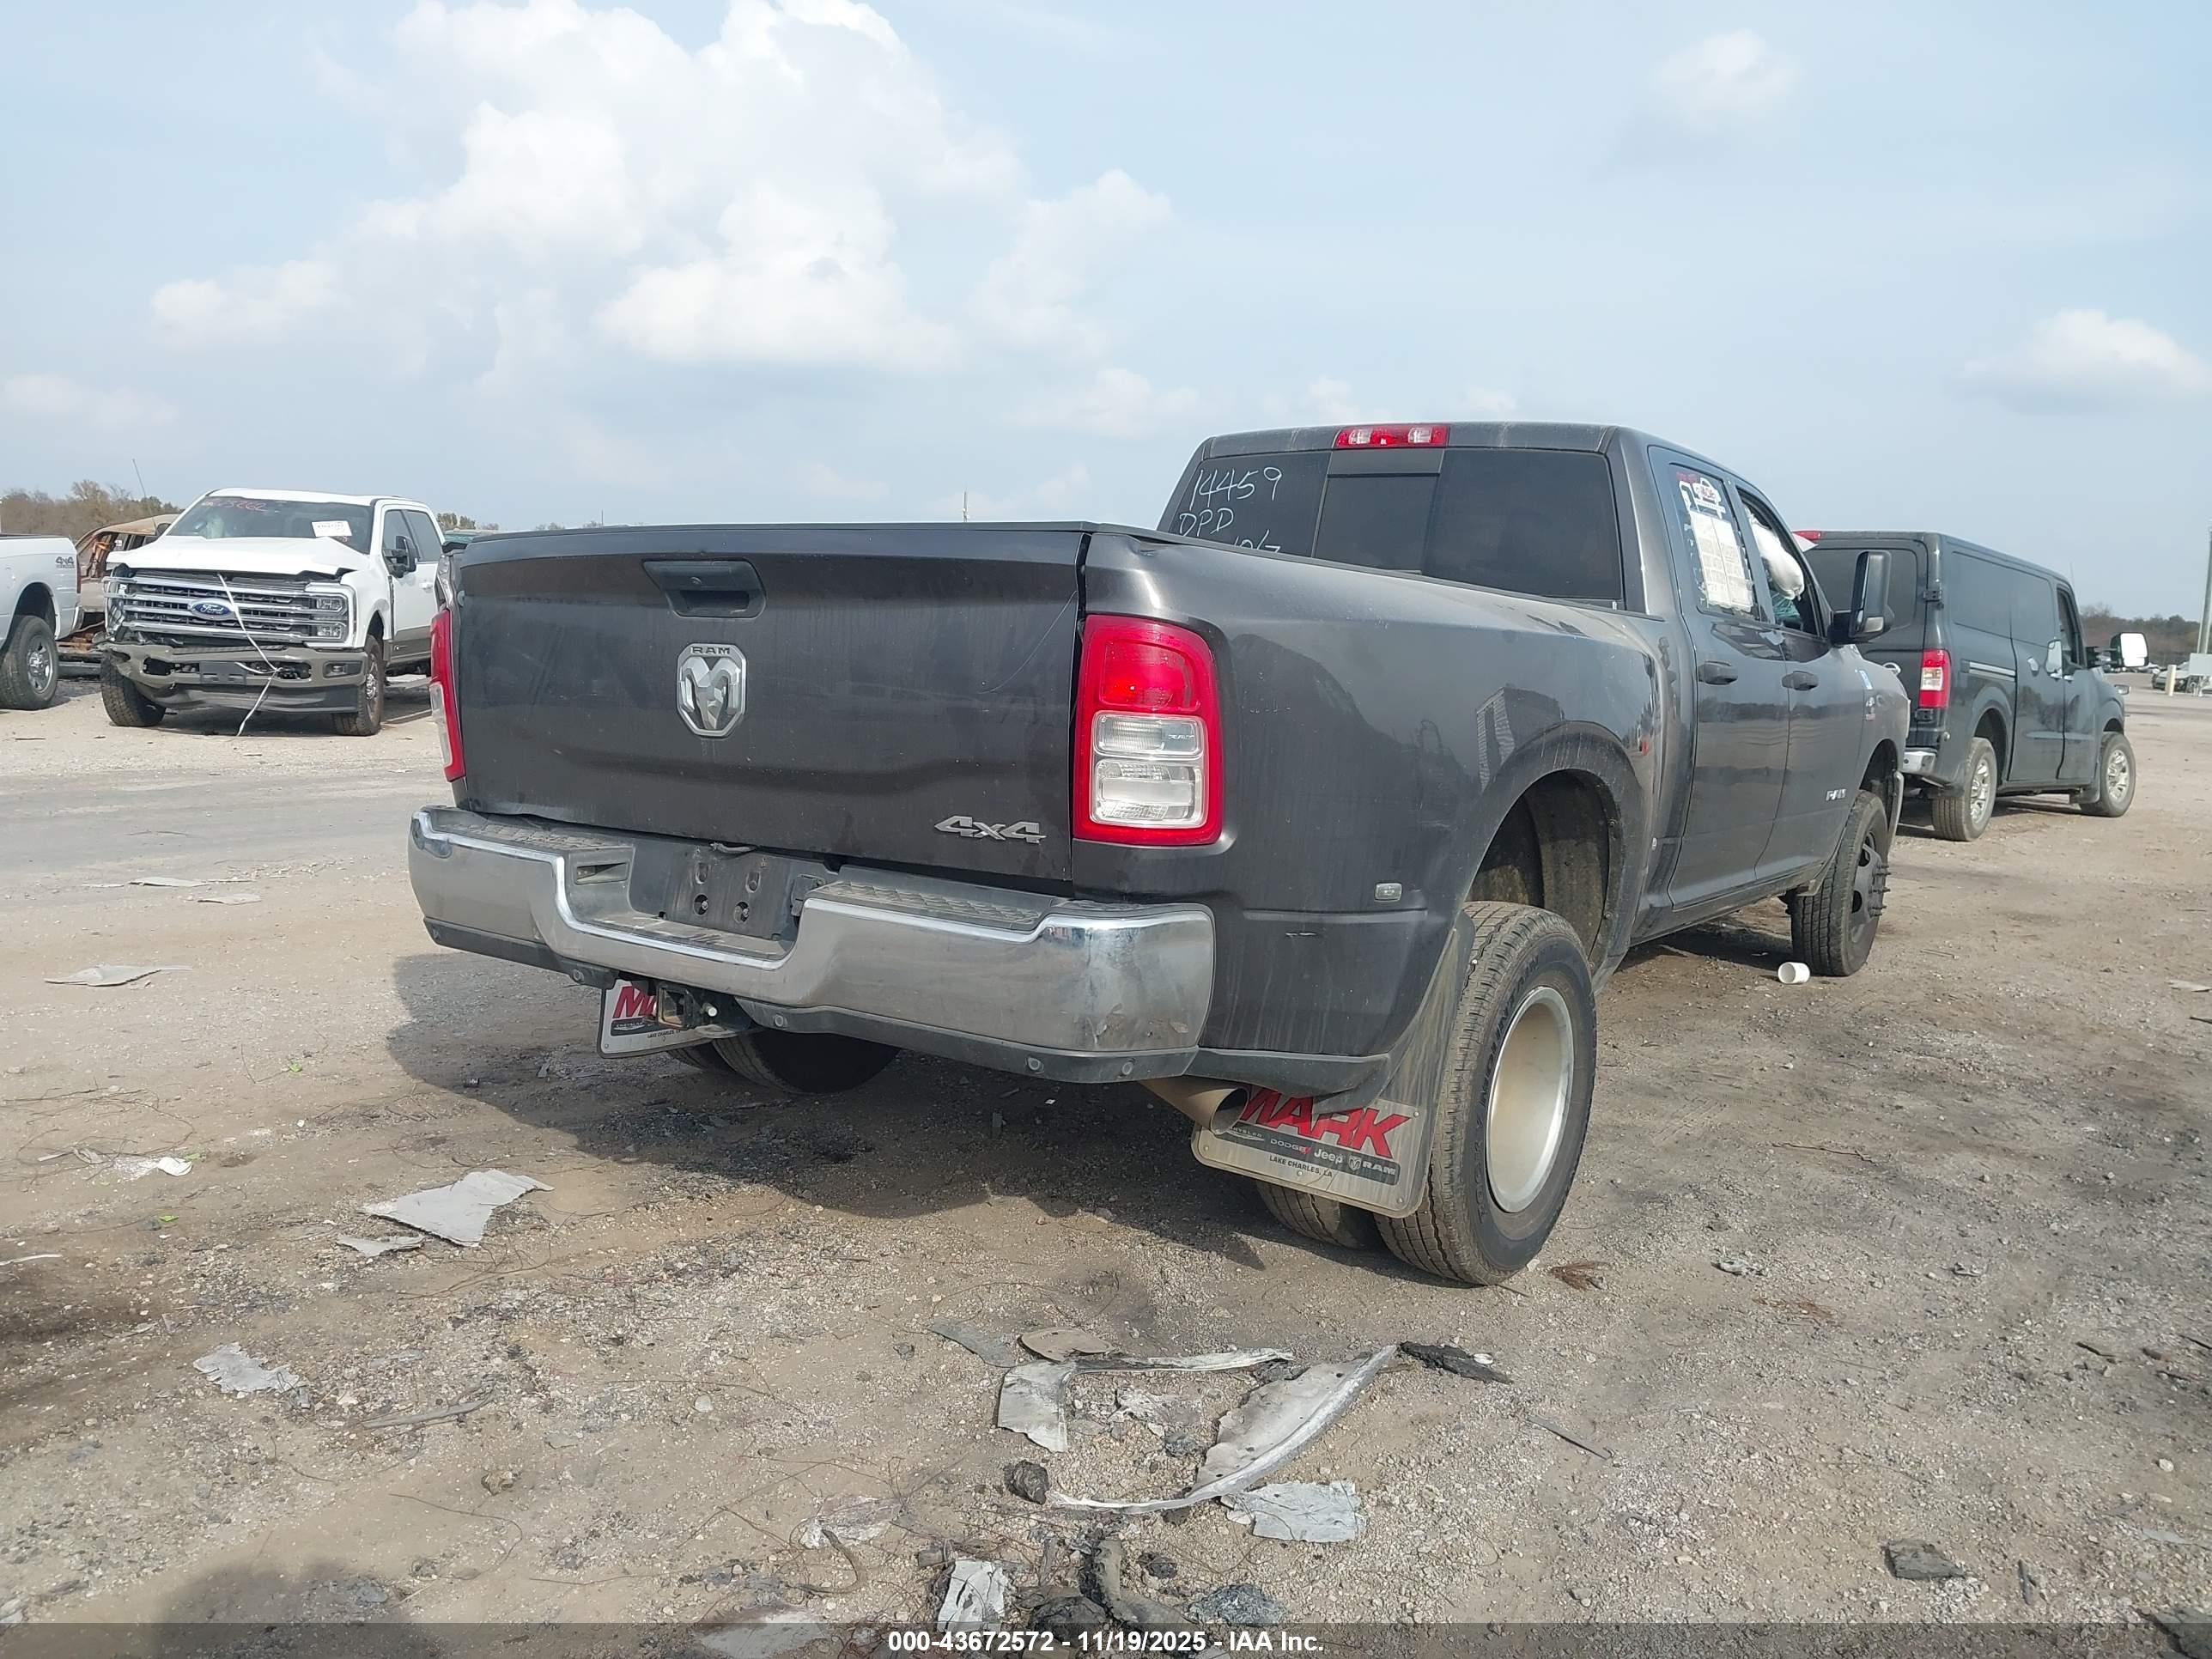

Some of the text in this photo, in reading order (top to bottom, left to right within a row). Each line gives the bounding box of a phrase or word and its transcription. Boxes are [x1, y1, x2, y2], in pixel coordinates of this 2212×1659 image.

[1188, 466, 1282, 511] 14459
[1179, 507, 1234, 537] DPD
[199, 603, 224, 615] Ford
[690, 646, 730, 654] RAM
[1269, 1155, 1287, 1166] LAKE
[1323, 1168, 1333, 1177] LA
[1270, 1138, 1308, 1152] DODGE
[1313, 1148, 1344, 1164] Jeep
[1362, 1160, 1396, 1176] RAM
